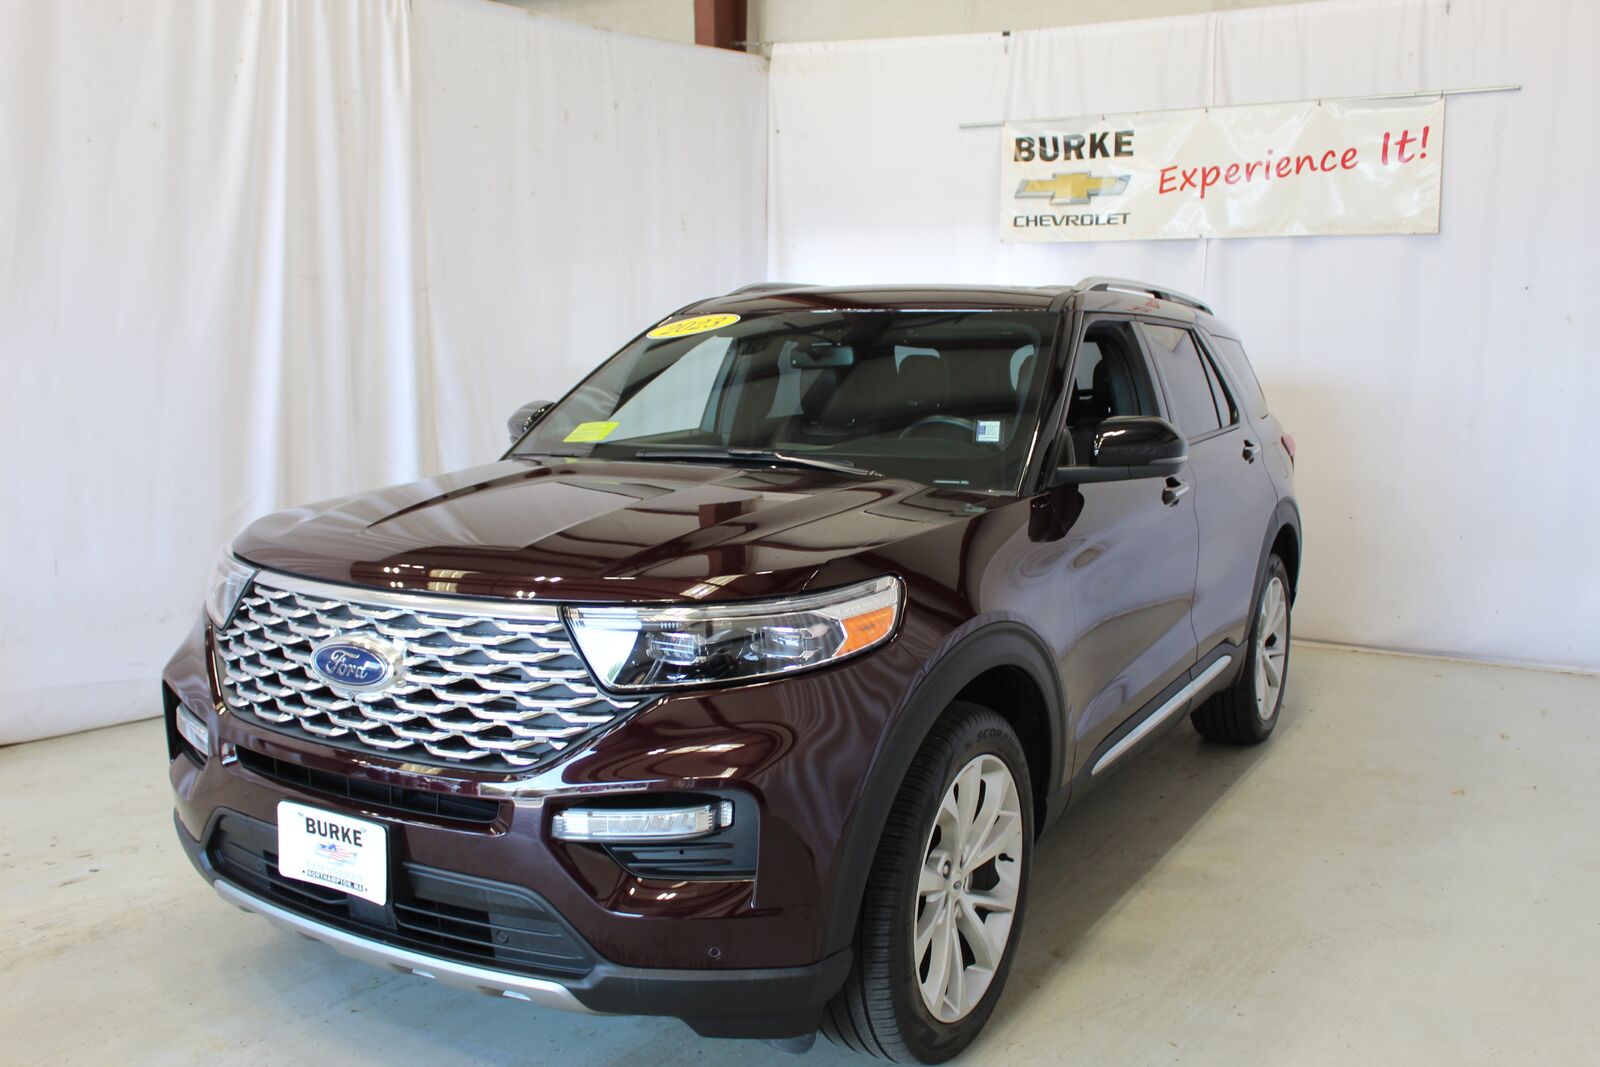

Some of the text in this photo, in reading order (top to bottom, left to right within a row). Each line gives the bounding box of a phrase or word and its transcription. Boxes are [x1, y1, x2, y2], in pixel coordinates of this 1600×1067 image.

[1014, 129, 1135, 162] BURKE
[1158, 126, 1430, 199] Experience It!
[1013, 212, 1132, 227] CHEVROLET
[658, 316, 728, 336] 2023
[325, 649, 370, 679] Ford
[305, 816, 363, 848] BURKE
